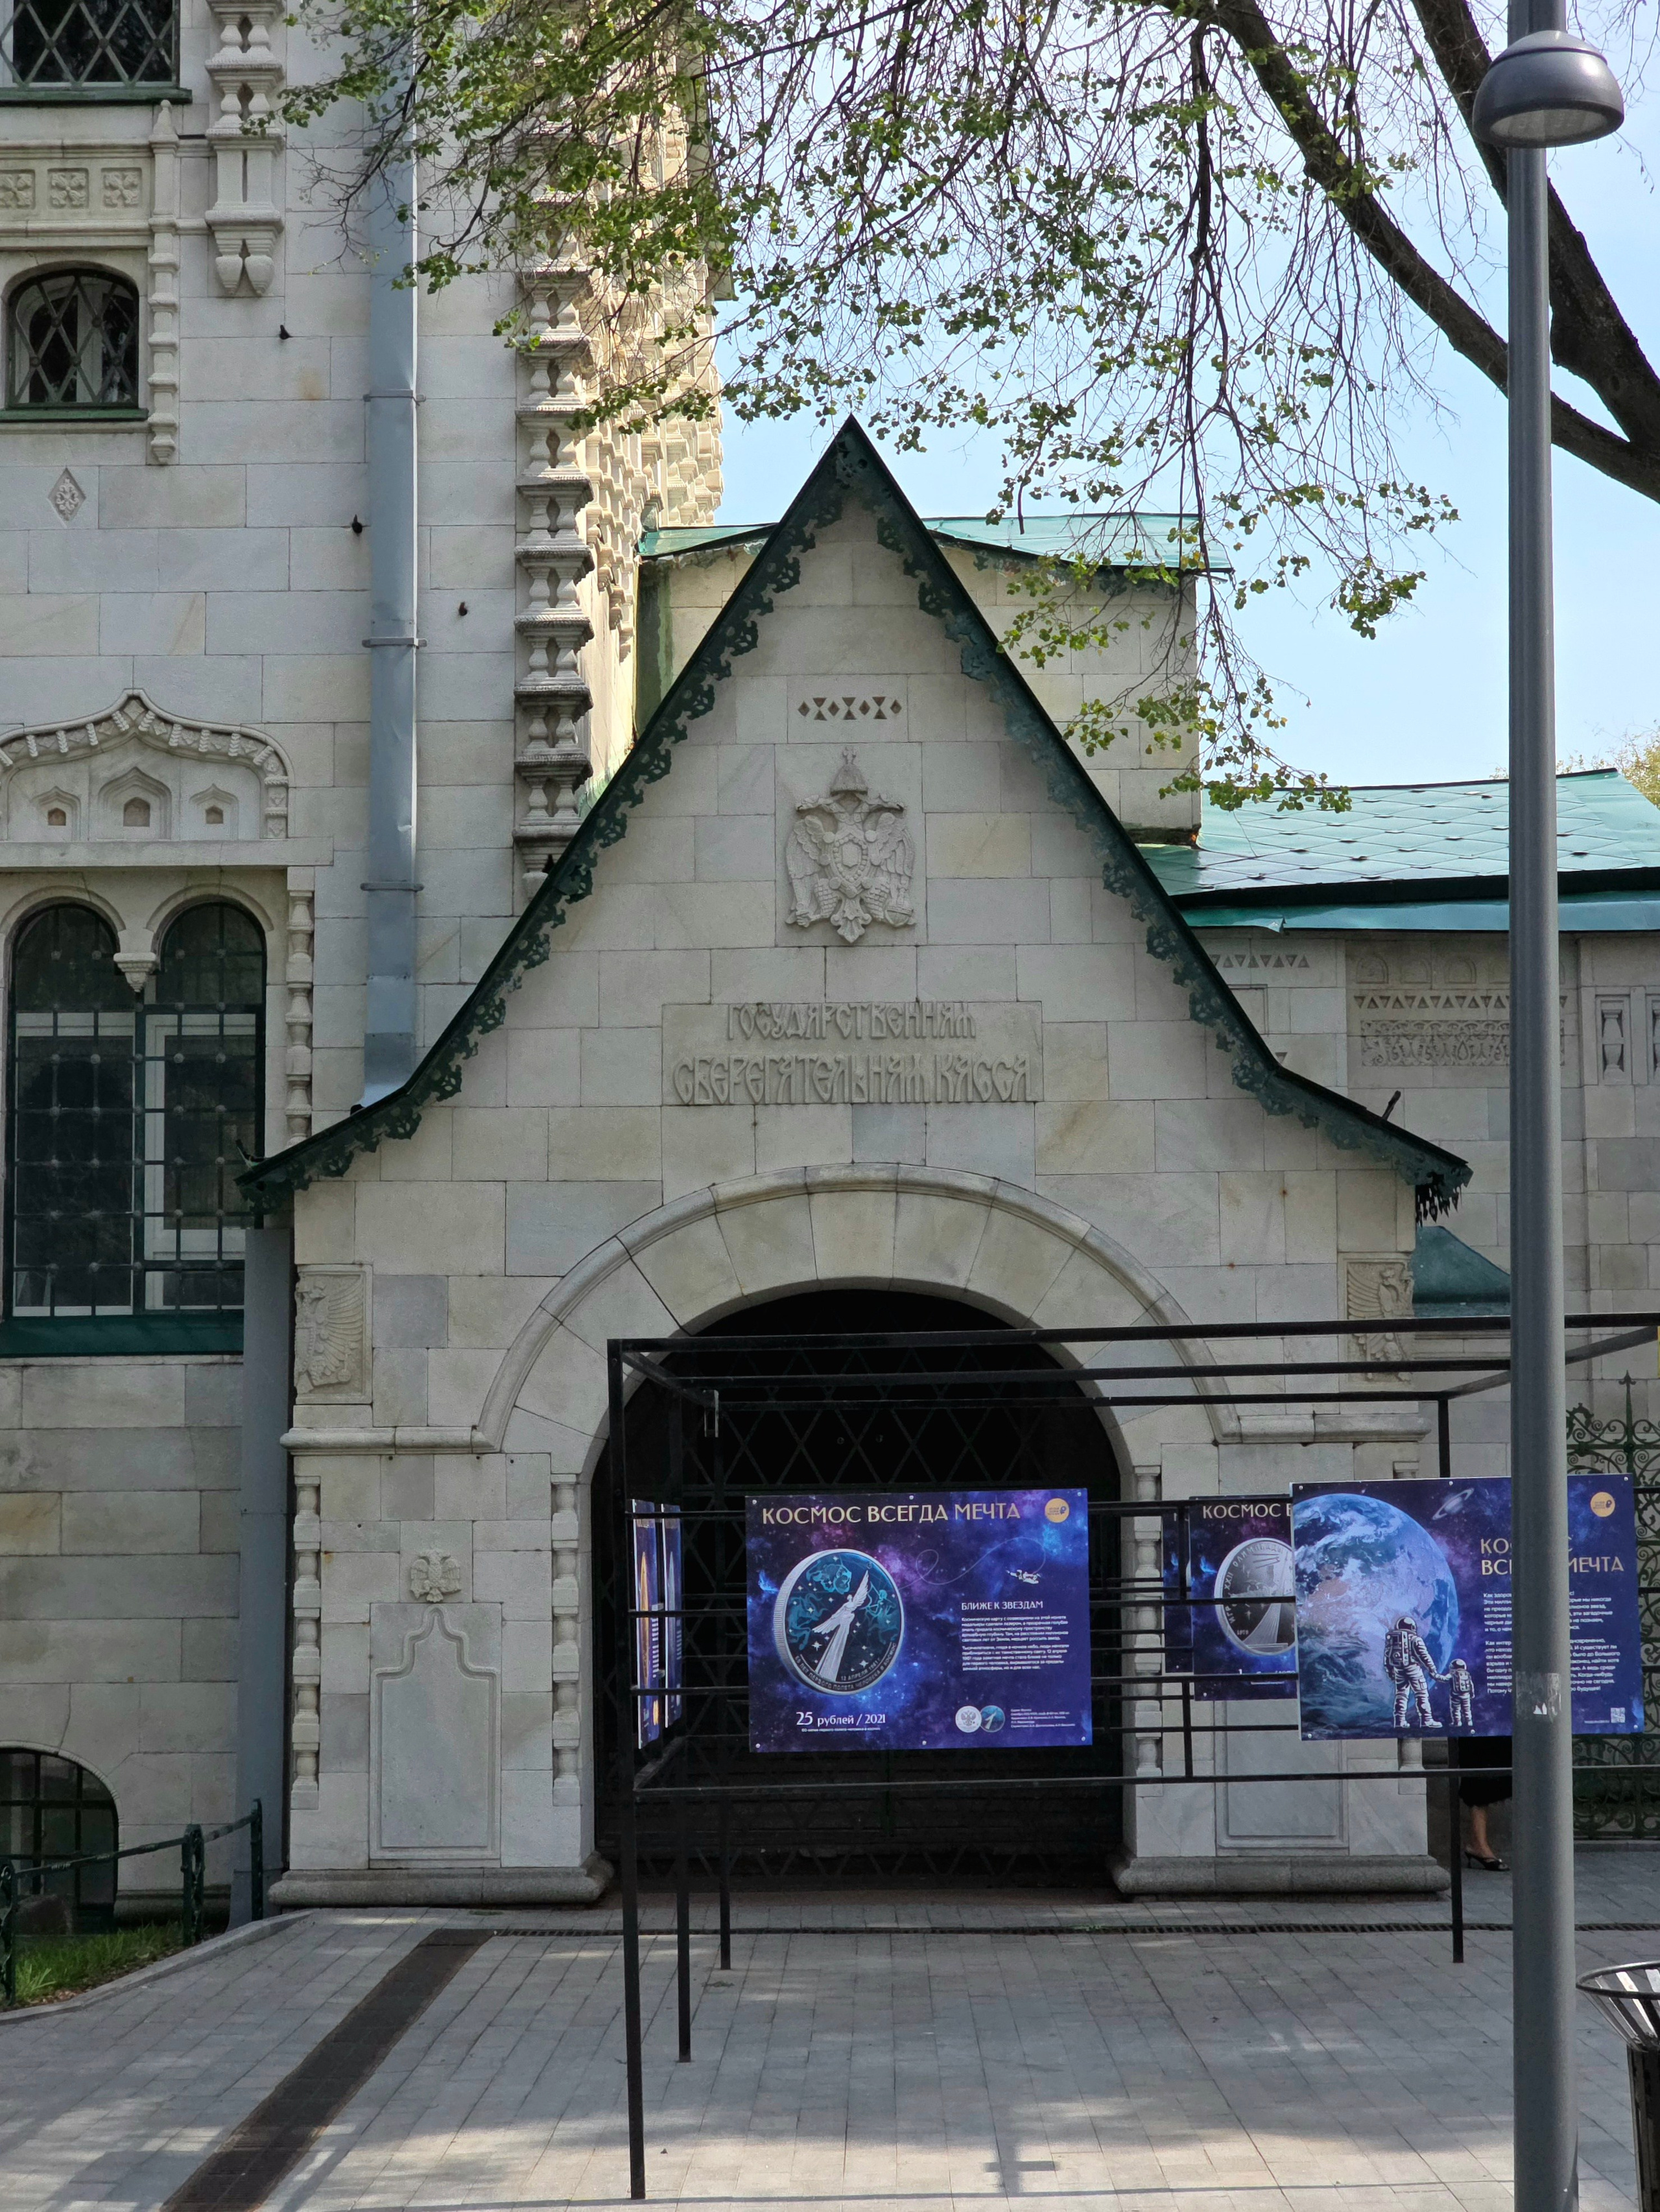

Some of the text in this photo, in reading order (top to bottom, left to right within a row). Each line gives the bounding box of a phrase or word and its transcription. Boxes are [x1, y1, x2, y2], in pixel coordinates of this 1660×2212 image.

[763, 1503, 1021, 1524] КОСМОС ВСЕГДА МЕЧТА
[1203, 1503, 1281, 1519] КОСМОС
[962, 1602, 993, 1610] БЛИЖЕ
[1002, 1601, 1043, 1610] ЗВЕЗДАМ
[796, 1712, 886, 1727] 25 рублей / 2021
